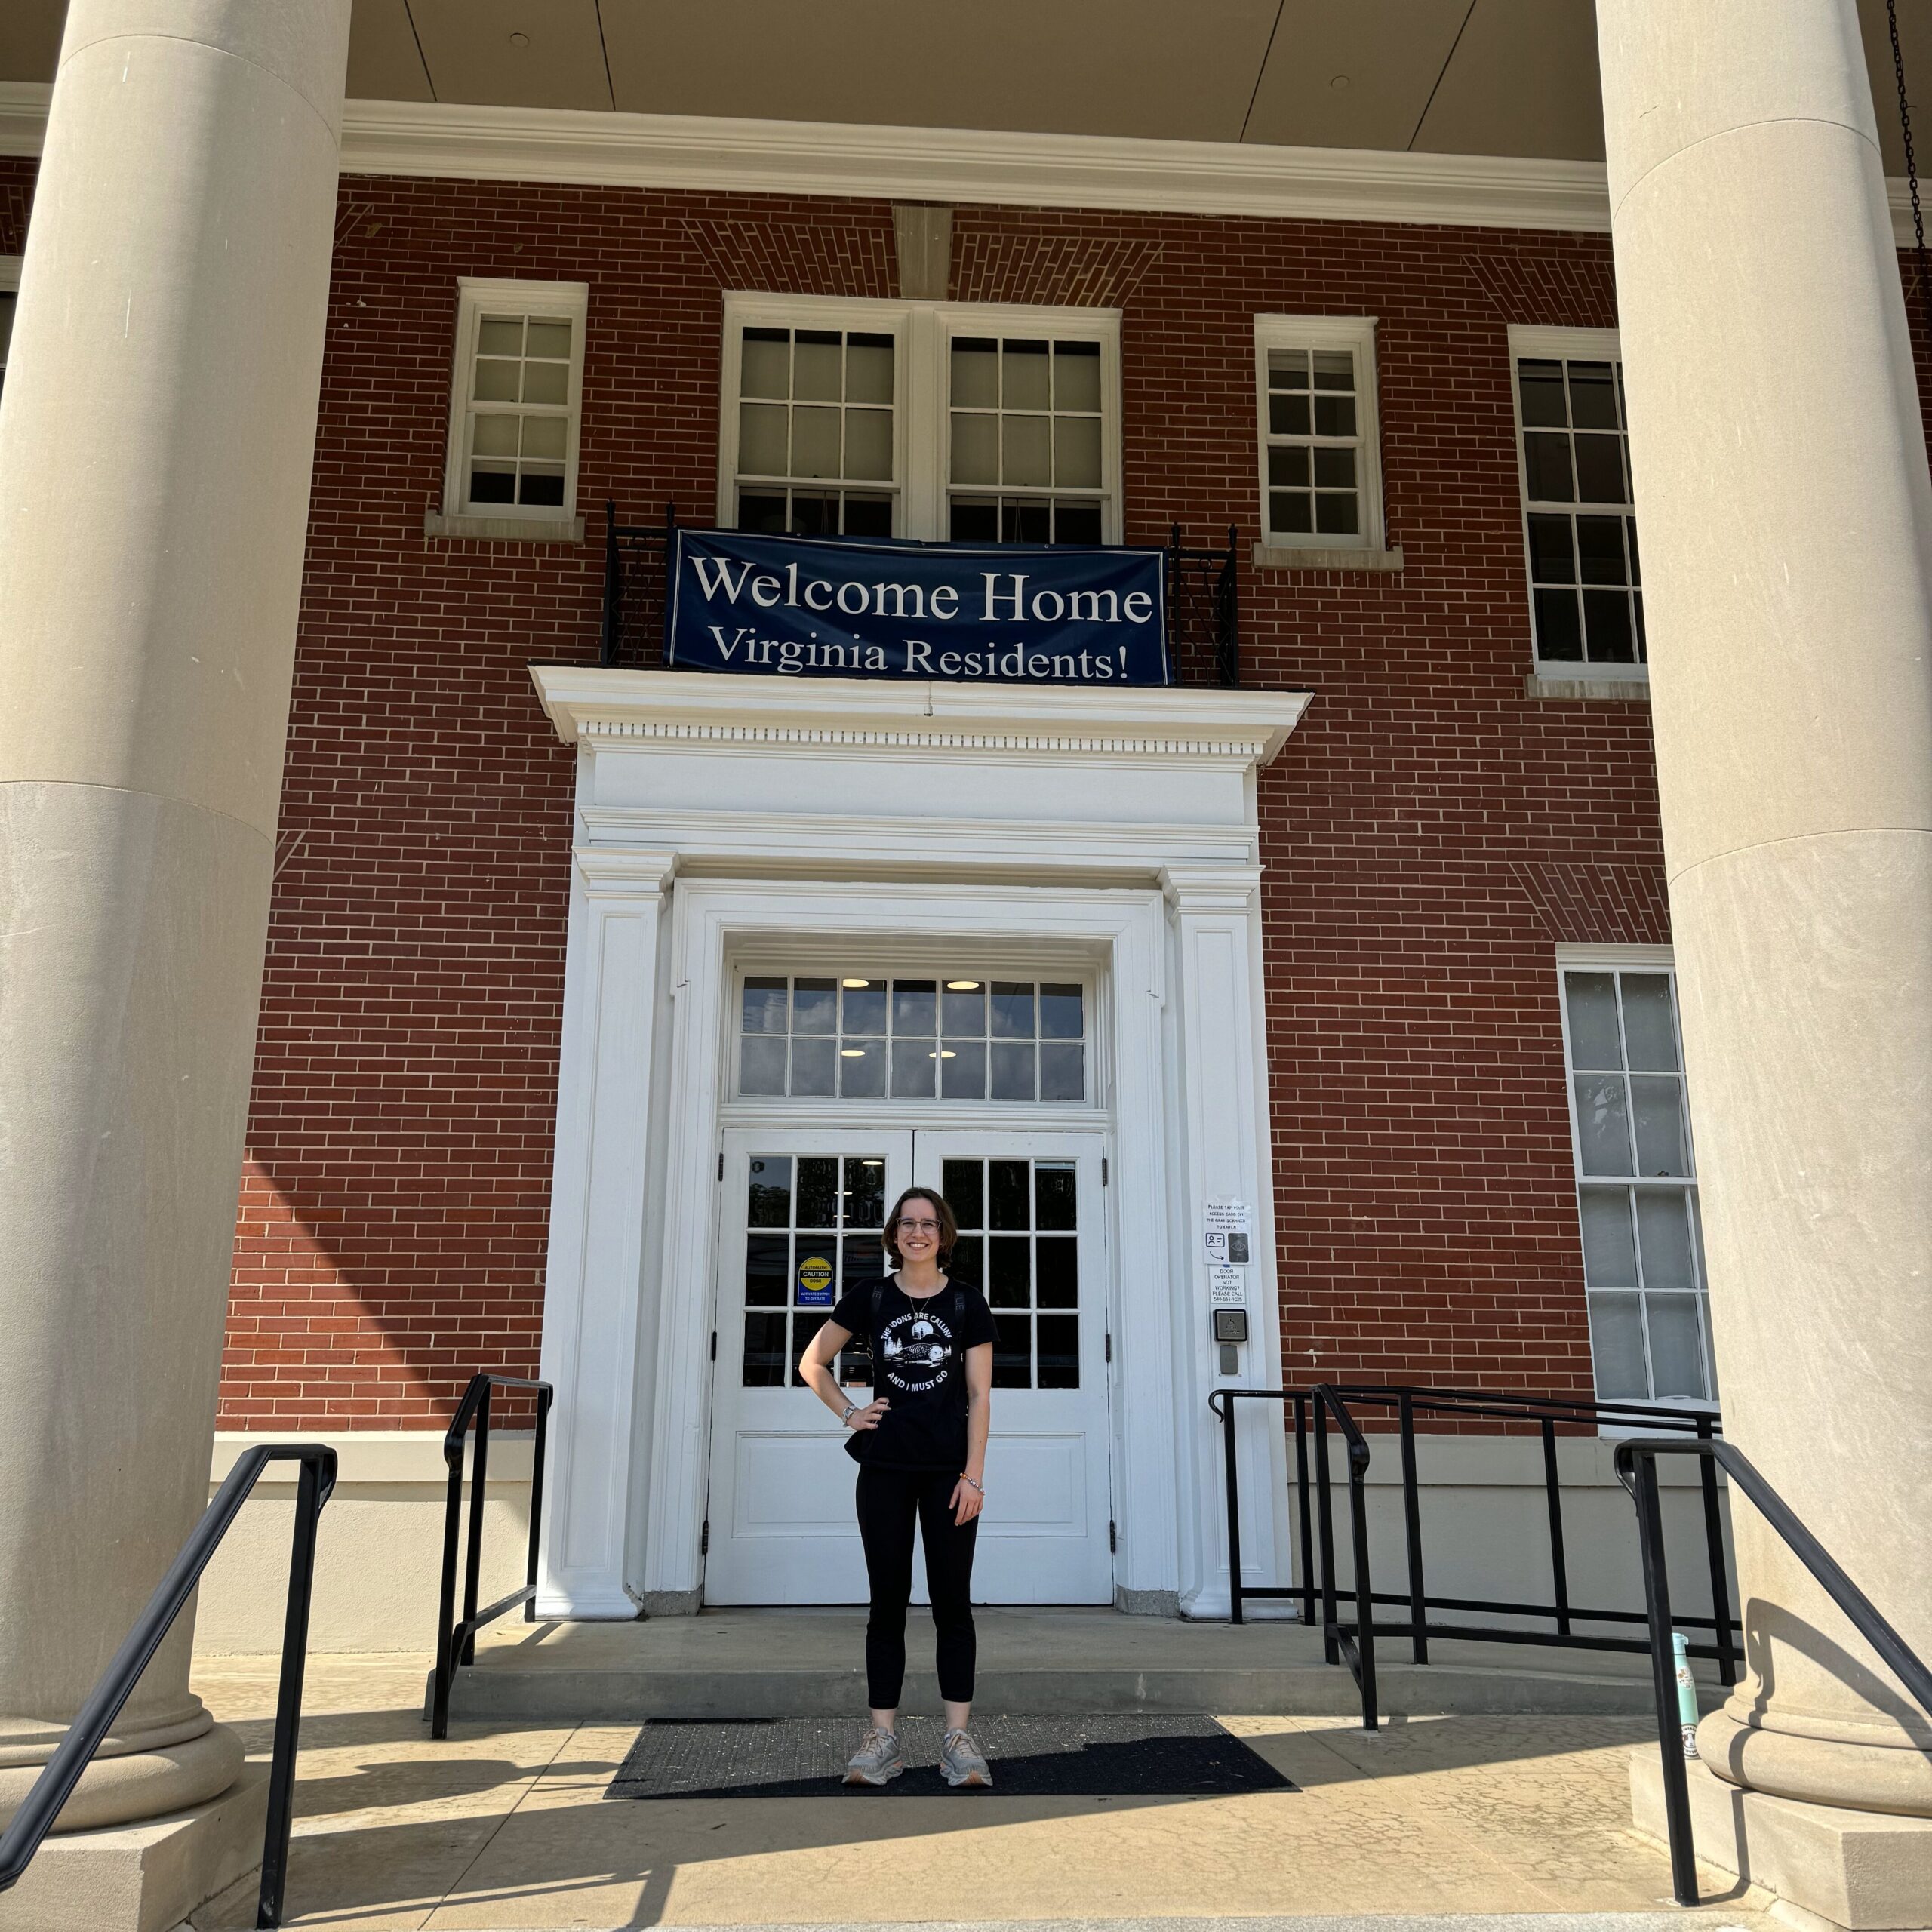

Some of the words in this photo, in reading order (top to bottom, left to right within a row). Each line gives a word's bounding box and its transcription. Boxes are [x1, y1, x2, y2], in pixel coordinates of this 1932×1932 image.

[688, 555, 958, 620] Welcome
[979, 572, 1153, 623] Home
[707, 626, 888, 673] Virginia
[902, 639, 1128, 679] Residents!
[881, 1327, 892, 1340] THE
[887, 1372, 906, 1388] AND
[906, 1383, 910, 1391] I
[911, 1380, 935, 1392] MUST
[936, 1370, 948, 1383] GO
